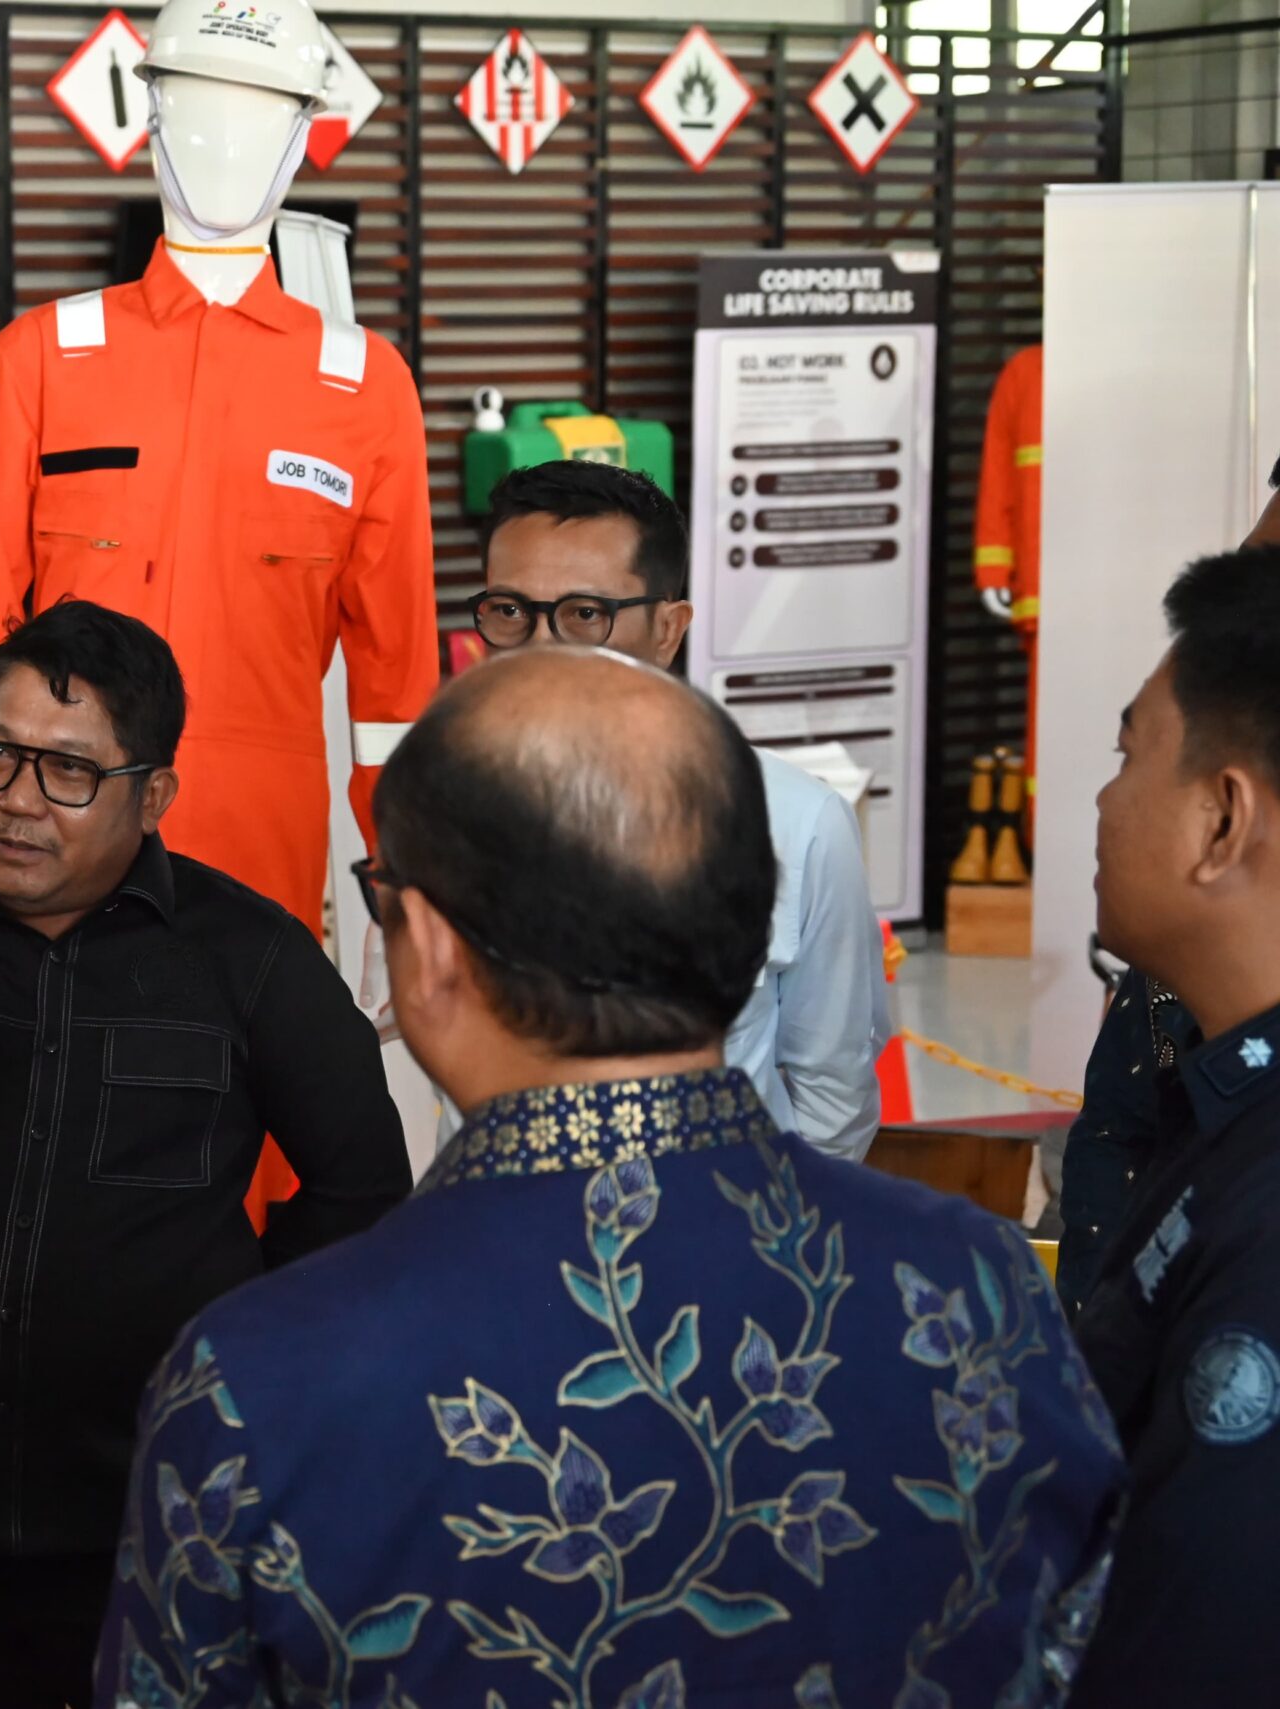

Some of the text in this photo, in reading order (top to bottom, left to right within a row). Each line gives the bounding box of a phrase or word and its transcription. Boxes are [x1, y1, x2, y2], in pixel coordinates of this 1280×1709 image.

[758, 267, 882, 292] CORPORATE
[723, 290, 914, 317] LIFE SAVING RULES
[277, 461, 347, 496] JOB TOMORI
